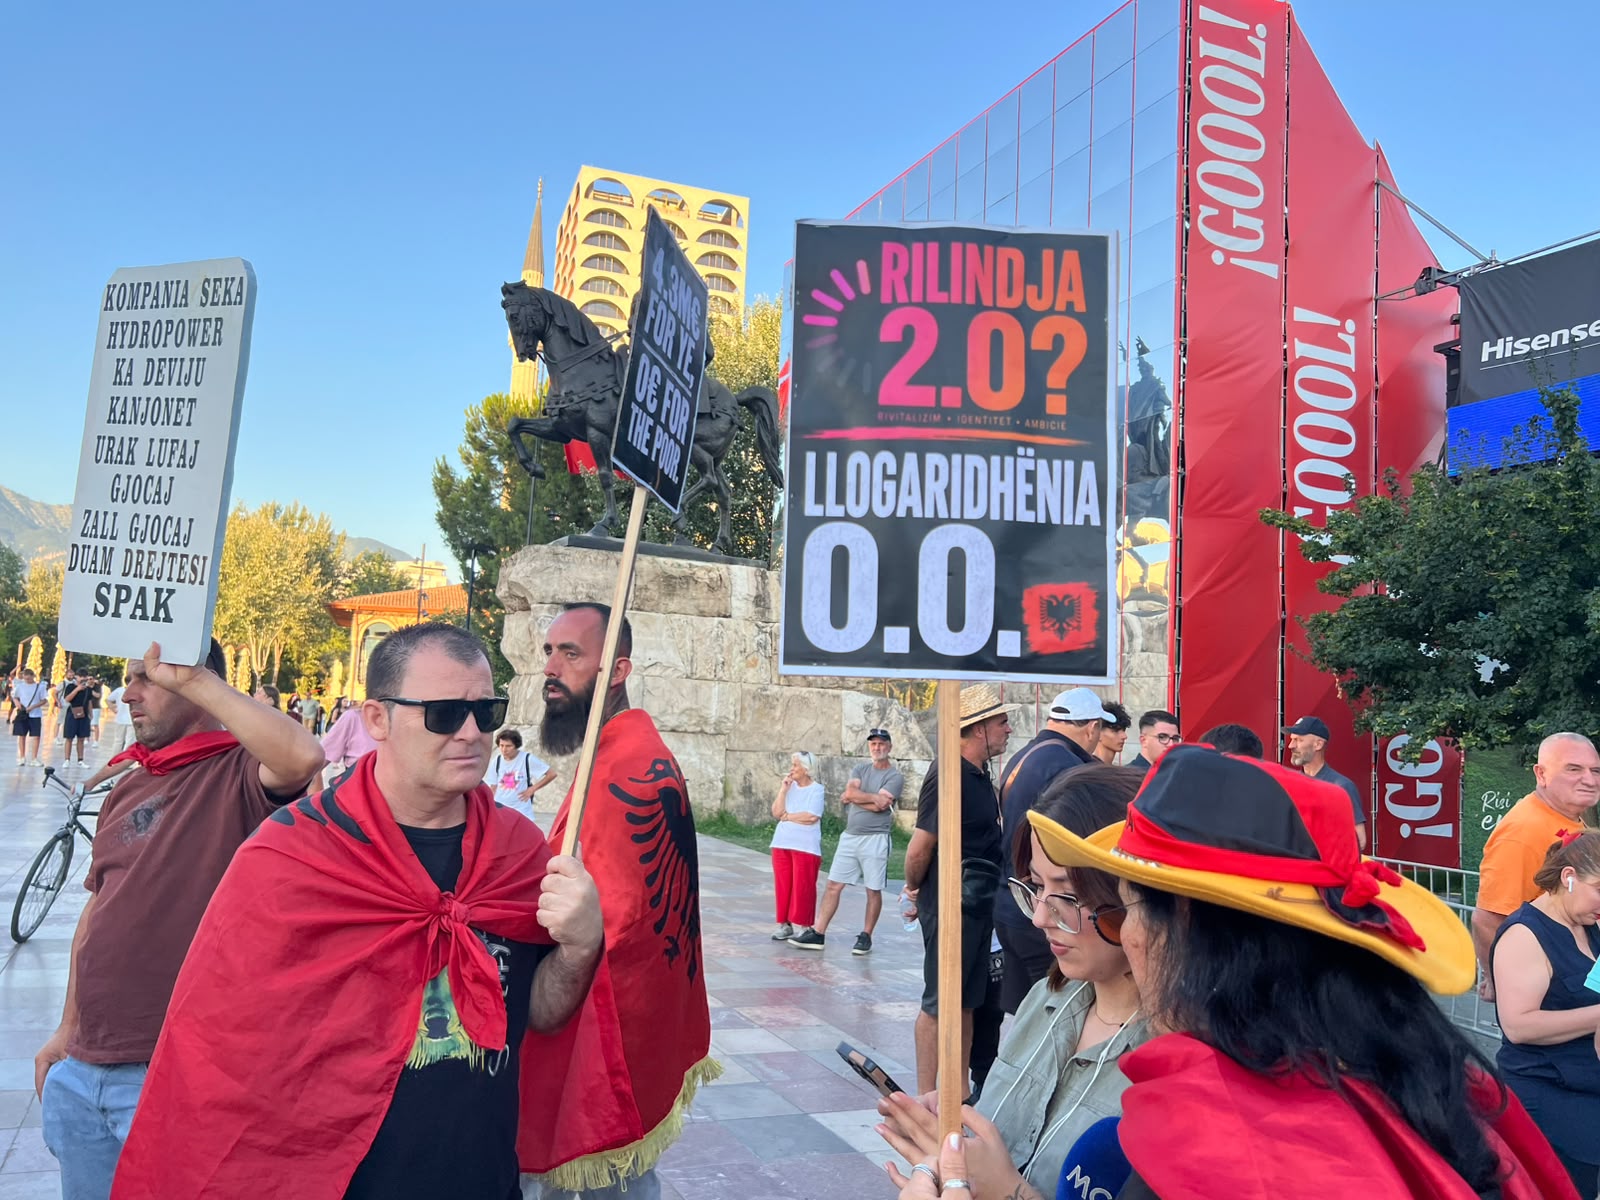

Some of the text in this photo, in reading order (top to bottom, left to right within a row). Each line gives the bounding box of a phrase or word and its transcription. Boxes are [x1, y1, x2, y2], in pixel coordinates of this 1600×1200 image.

[103, 276, 244, 312] KOMPANIA SEKA
[652, 247, 701, 341] 4.3M€
[880, 241, 1087, 312] RILINDJA
[106, 317, 224, 350] HYDROPOWER
[644, 288, 696, 390] FOR YE,
[1481, 320, 1600, 362] Hisense
[112, 357, 206, 387] KA DEVIJU
[878, 306, 1088, 415] 2.0?
[106, 396, 197, 427] KANJONET
[635, 353, 690, 446] 0€ FOR
[957, 415, 1012, 426] IDENTITET
[94, 435, 200, 470] URAK LUFAJ
[627, 401, 681, 484] THE POOR.
[110, 473, 175, 505] GJOCAJ
[804, 446, 1101, 526] LLOGARIDHËNIA
[80, 509, 194, 548] ZALL GJOCAJ
[68, 543, 208, 586] DUAM DREJTESI
[93, 581, 176, 623] SPAK
